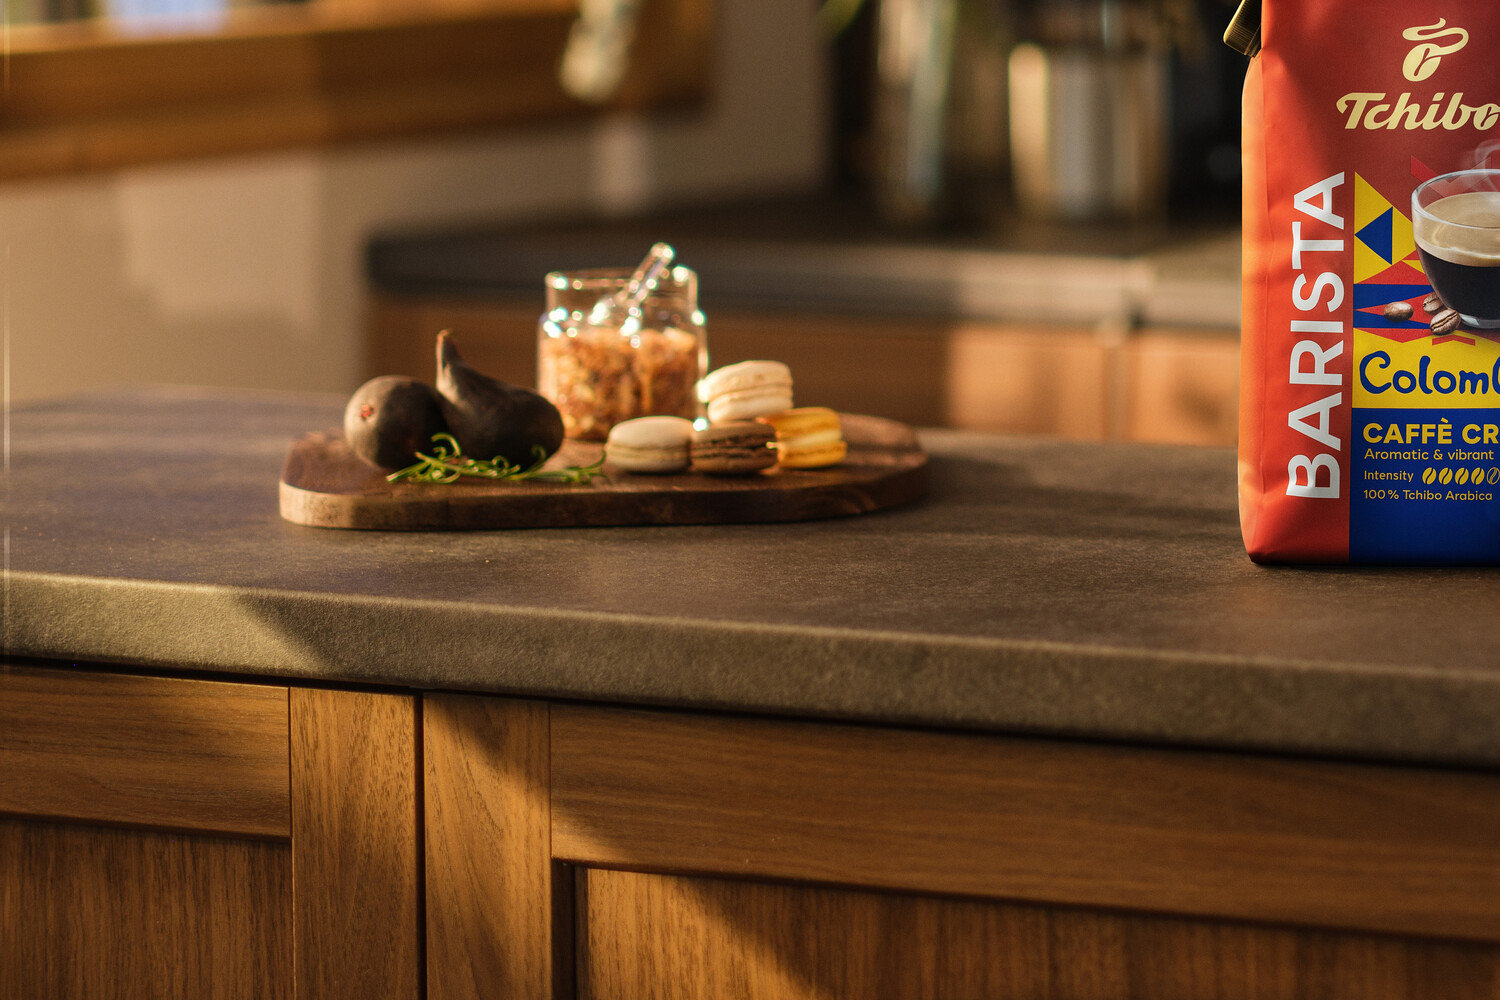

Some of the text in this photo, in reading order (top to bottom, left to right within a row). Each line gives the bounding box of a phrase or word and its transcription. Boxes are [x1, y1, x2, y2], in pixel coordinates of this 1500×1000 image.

[1286, 171, 1345, 499] BARISTA
[1363, 417, 1452, 444] CAFFÈ
[1364, 448, 1494, 460] Aromatic & vibrant
[1364, 470, 1414, 483] Intensity
[1403, 489, 1442, 500] Tchibo
[1445, 490, 1492, 501] Arabica
